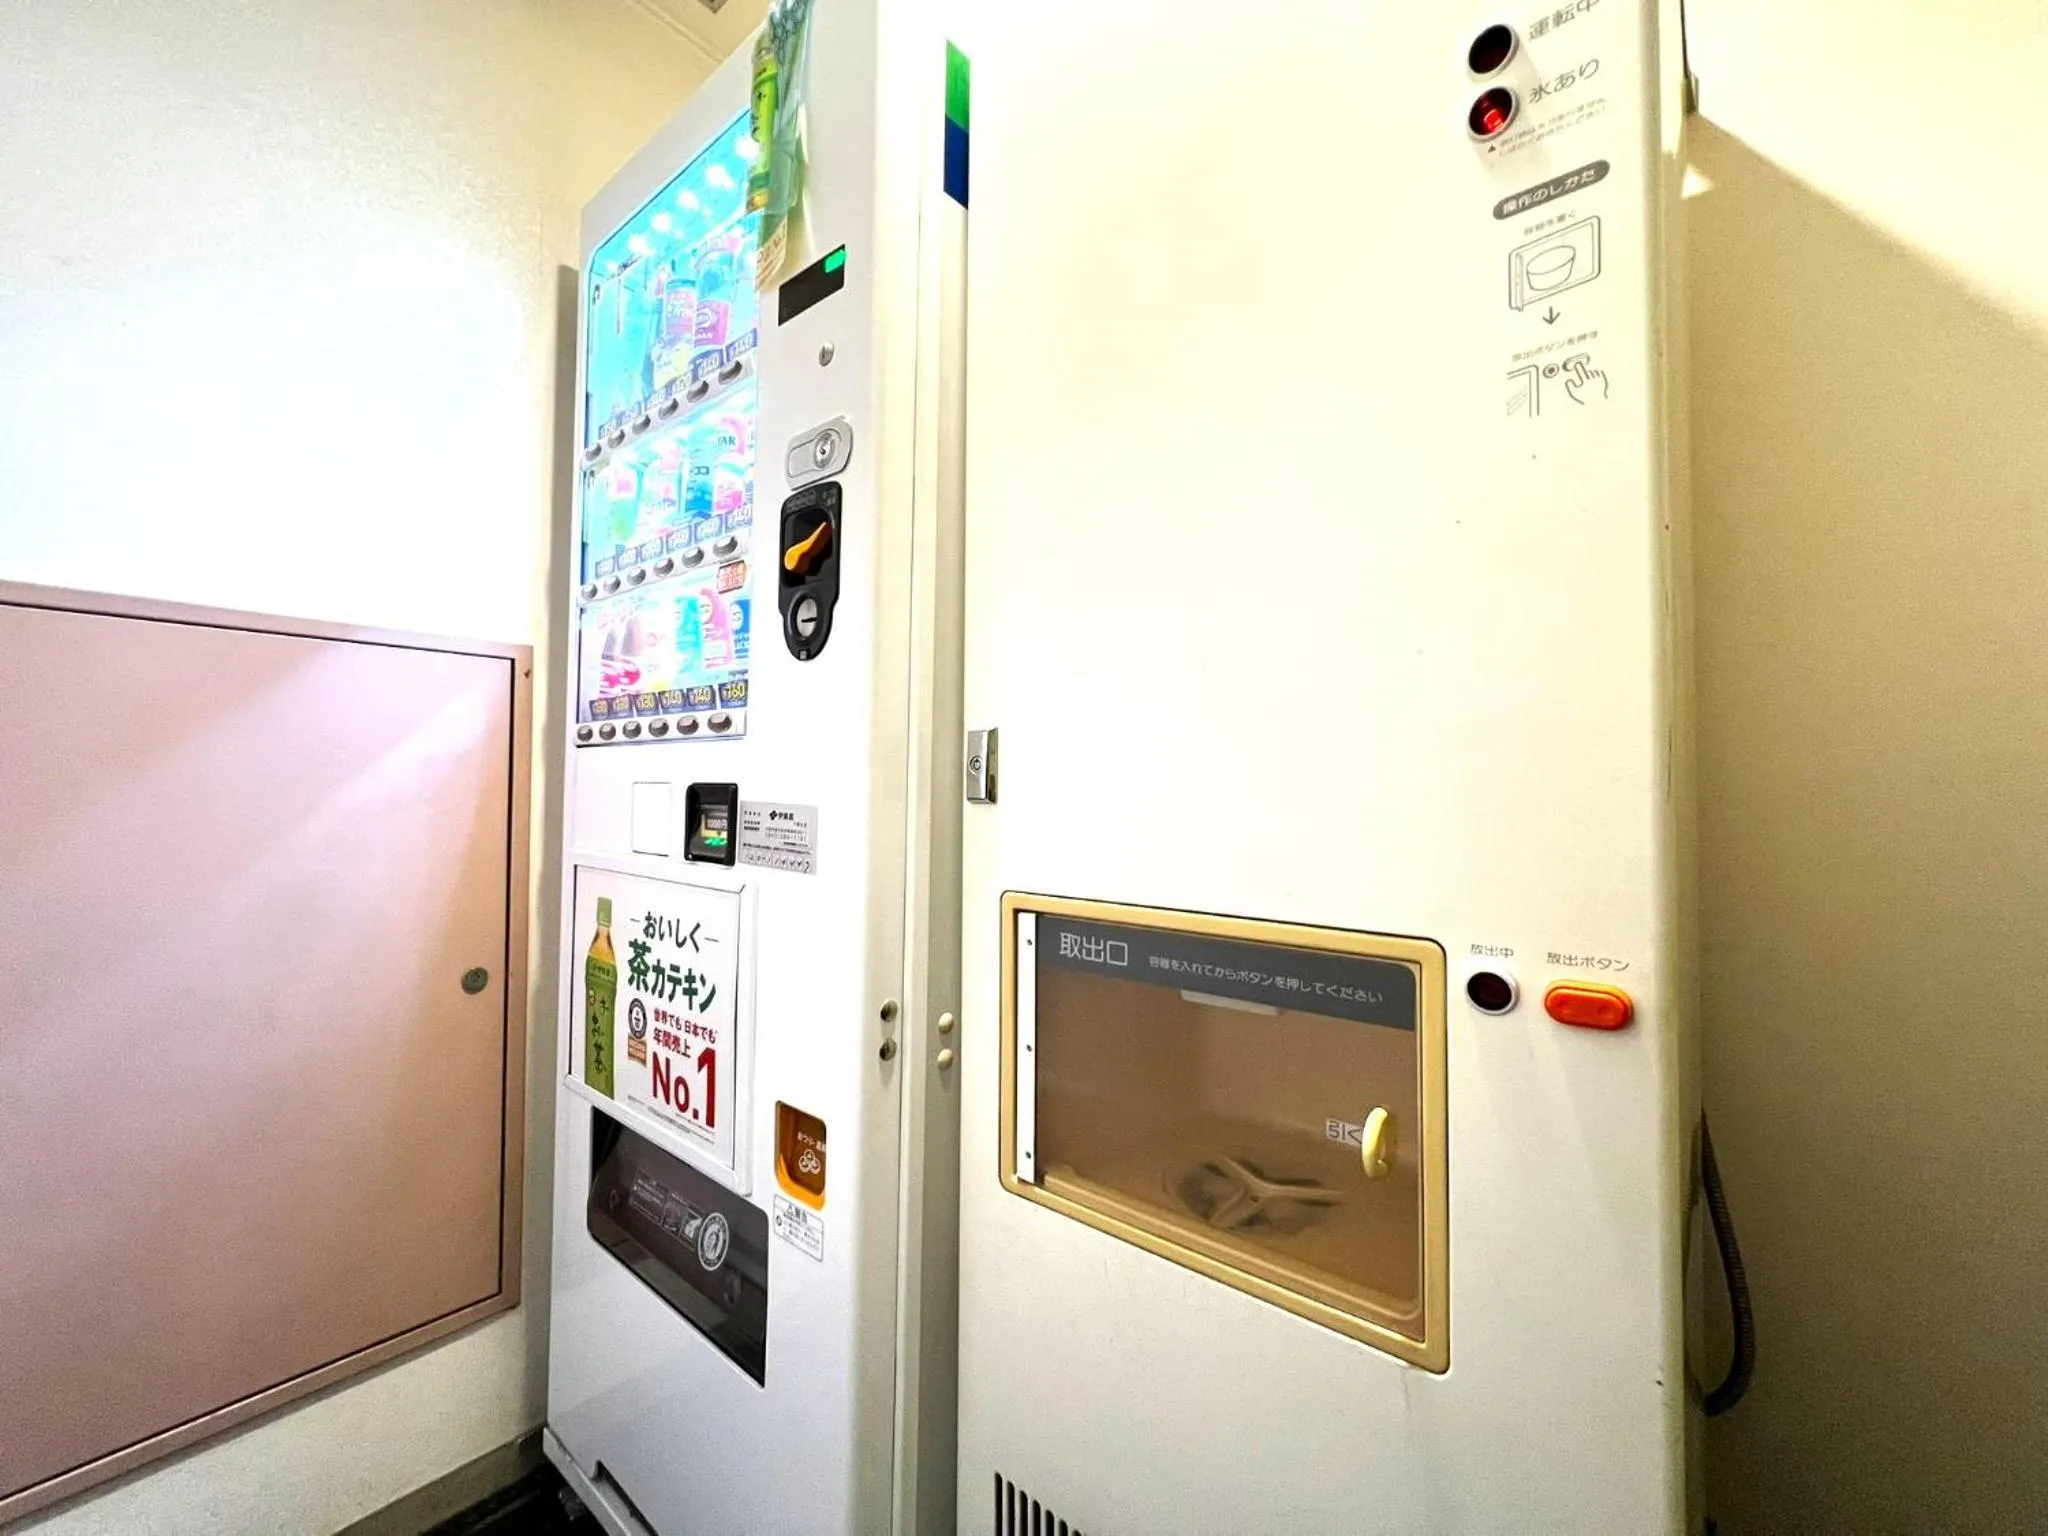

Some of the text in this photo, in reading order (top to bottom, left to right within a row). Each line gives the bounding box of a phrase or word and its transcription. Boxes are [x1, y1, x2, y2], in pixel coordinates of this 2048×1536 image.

[1529, 58, 1600, 105] 氷あり
[1503, 168, 1597, 215] 操作のしかた
[643, 911, 701, 953] おいしく
[1059, 931, 1129, 966] 取出口
[1470, 943, 1515, 959] 放出中
[628, 938, 716, 1013] 茶カテキン
[1149, 955, 1384, 1003] 容器を入れてからボタンを押してください
[1546, 951, 1630, 972] 放出ボタン
[653, 1027, 691, 1059] 年間売上
[652, 1047, 716, 1129] No.1
